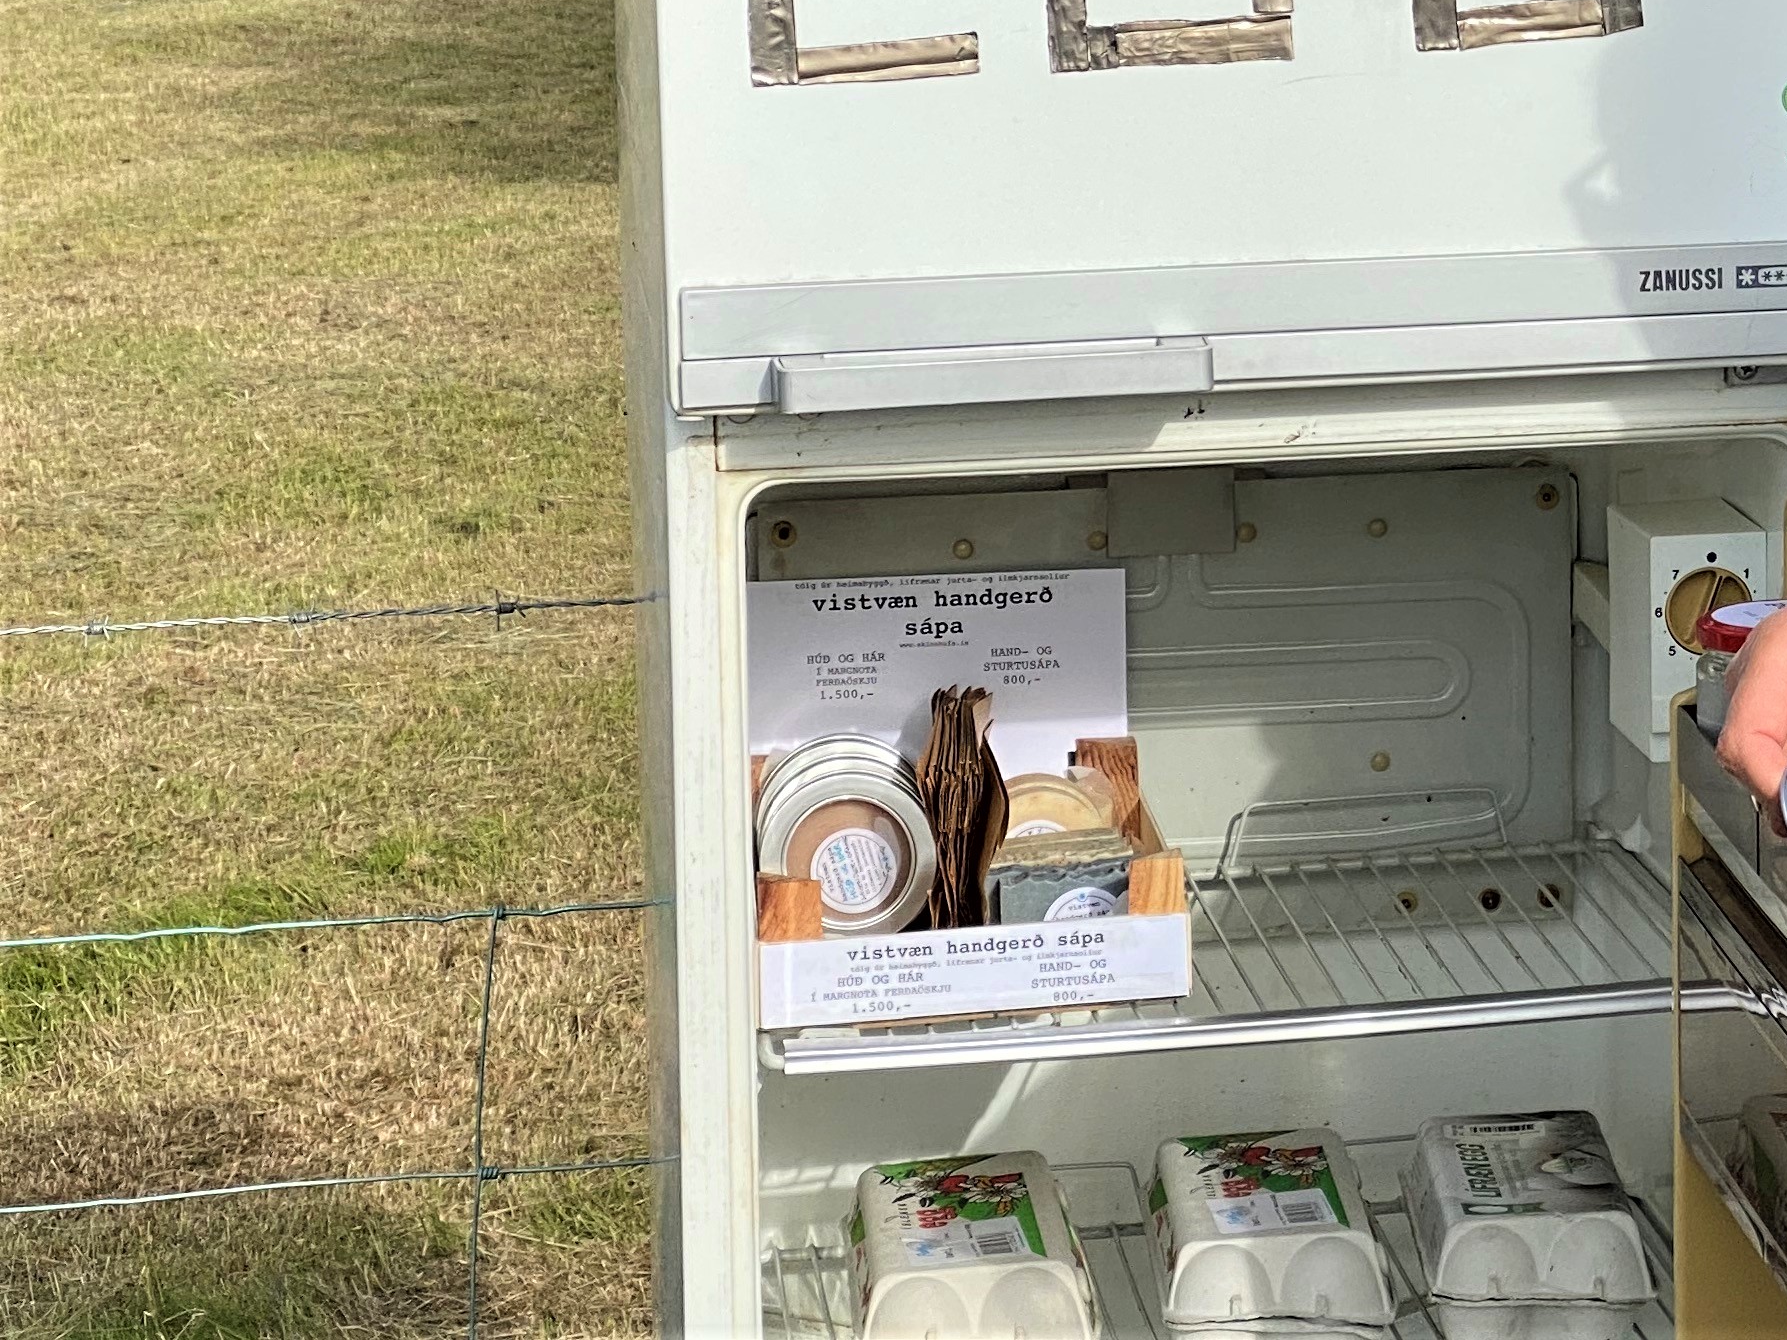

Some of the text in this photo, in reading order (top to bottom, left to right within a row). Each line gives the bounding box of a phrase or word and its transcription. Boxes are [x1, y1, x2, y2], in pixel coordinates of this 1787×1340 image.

[1639, 267, 1723, 292] ZANUSSI
[1672, 569, 1679, 580] 7
[1743, 568, 1750, 579] 1
[812, 586, 1053, 611] vistvæn handgerð
[1654, 607, 1663, 618] 6
[905, 617, 964, 639] sápa
[990, 645, 1052, 657] HAND- OG
[1668, 645, 1677, 657] 5
[806, 651, 886, 665] HÚÐ OG HÁR
[828, 666, 877, 675] MARGNOTA
[983, 659, 1060, 672] STURTUSÁPA
[1003, 674, 1041, 685] 800,-
[820, 689, 874, 700] 1.500,-
[847, 930, 1105, 961] vistvæn handgerð sápa
[1039, 959, 1107, 973] HAND- OG
[837, 972, 923, 987] HÚÐ OG HÁR
[1031, 972, 1116, 989] STURTUSÁPA
[823, 990, 878, 1001] MARGNOTA
[884, 984, 951, 998] FERÐAÖSKJU
[1053, 990, 1094, 1002] 800,-
[852, 1001, 911, 1014] 1.500,-
[1455, 1143, 1490, 1162] EGG
